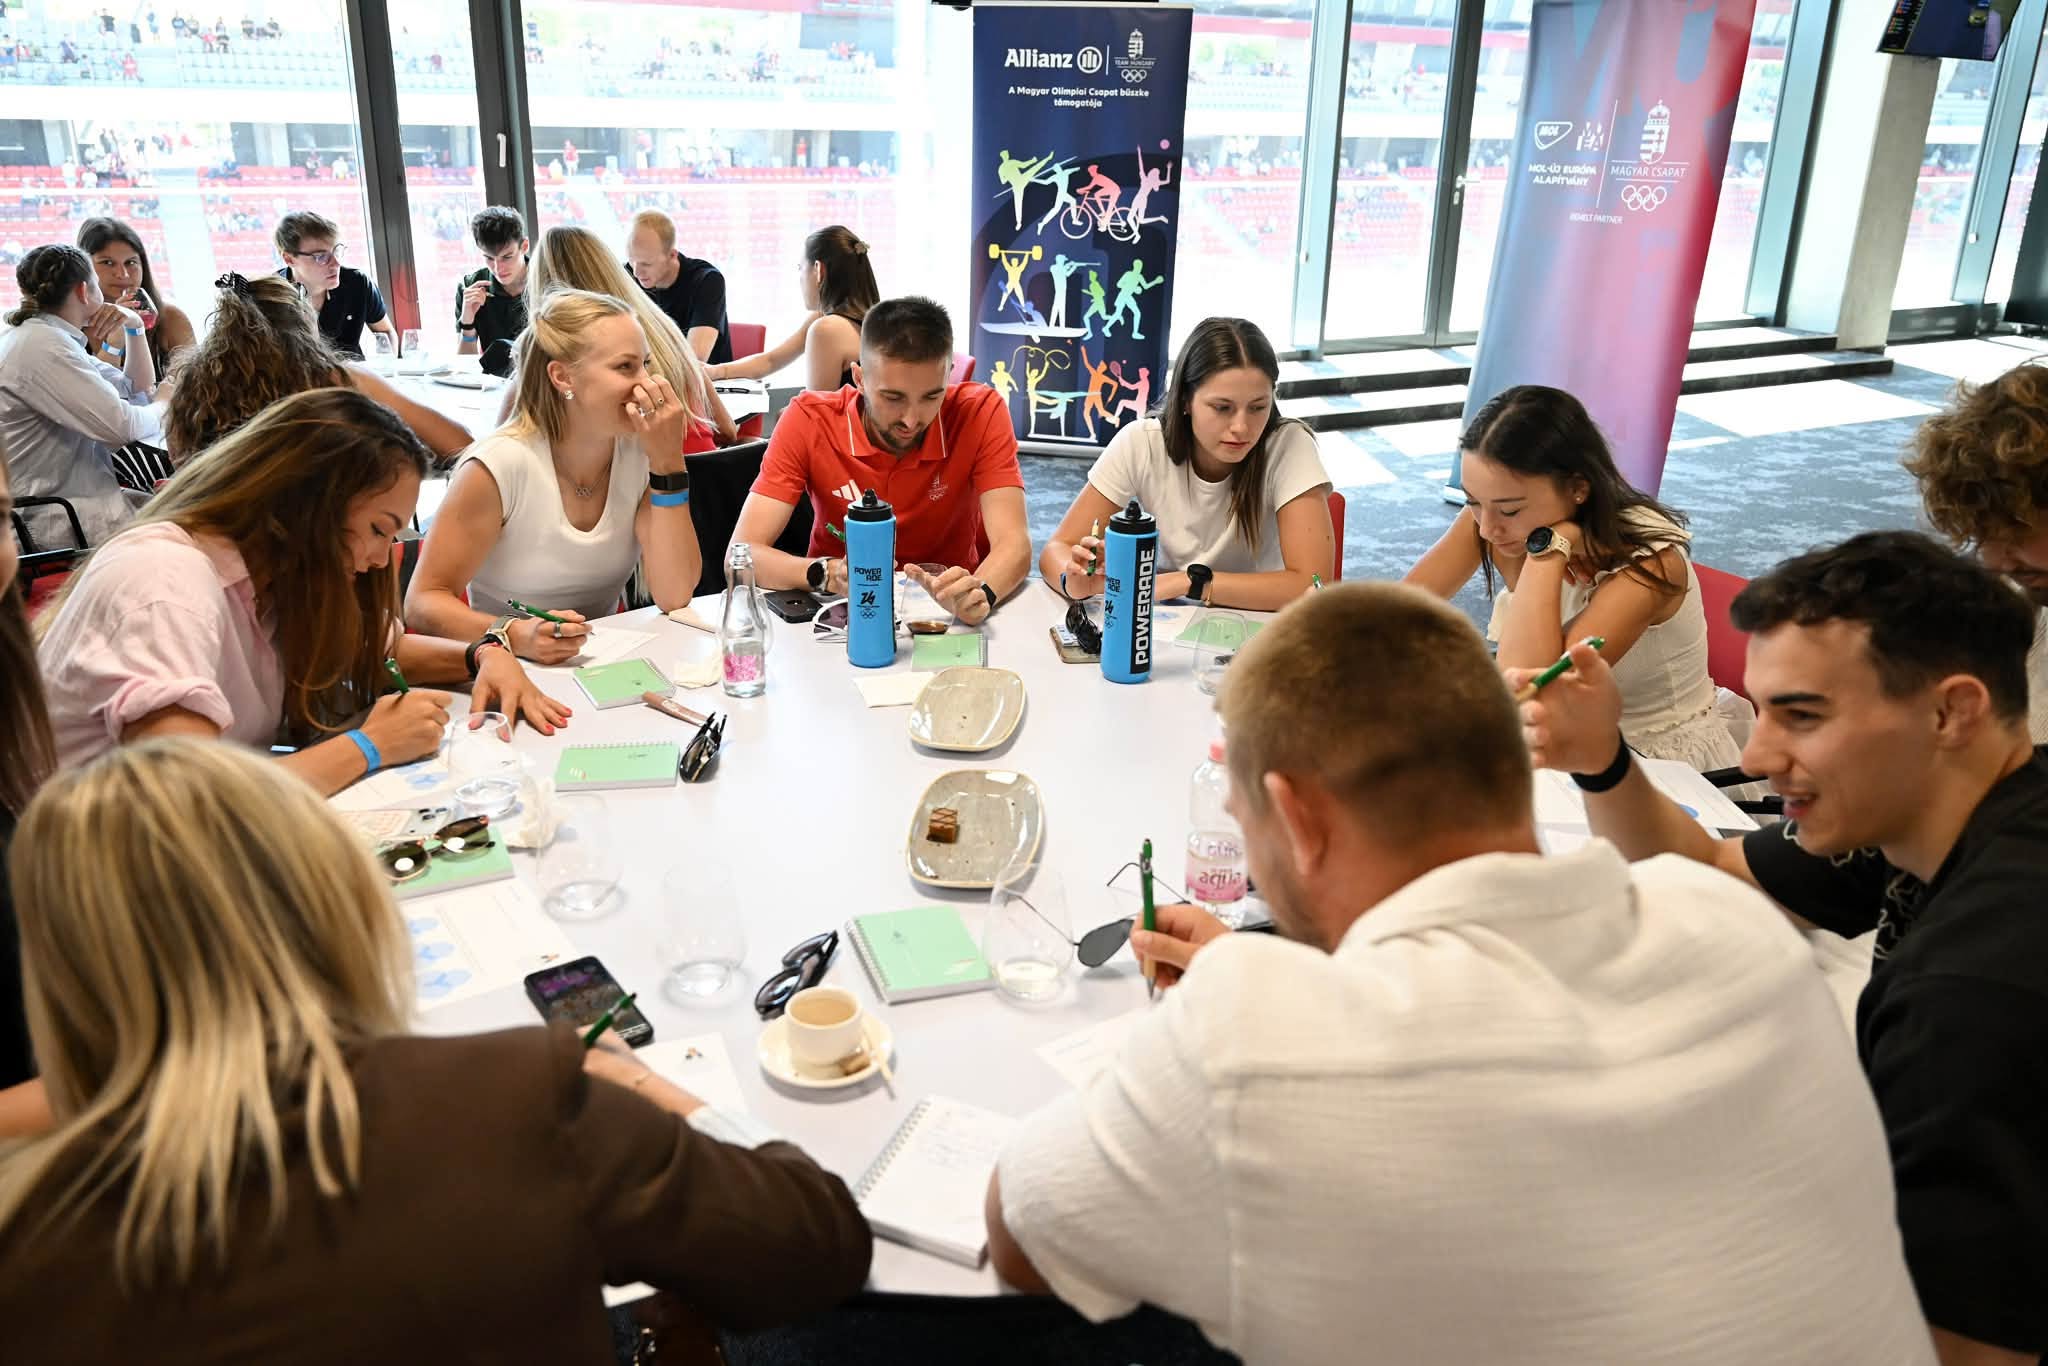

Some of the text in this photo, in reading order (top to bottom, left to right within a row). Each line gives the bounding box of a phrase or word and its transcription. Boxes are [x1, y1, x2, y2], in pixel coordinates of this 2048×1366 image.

[1004, 48, 1073, 68] Allianz
[1008, 87, 1149, 98] A Magyar Olimpiai Csapat büszke
[1054, 98, 1103, 109] támogatója
[1539, 125, 1559, 136] MOL
[1563, 162, 1597, 176] EURÓPA
[1610, 166, 1686, 178] MAGYAR CSAPAT
[1533, 174, 1590, 187] ALAPÍTVÁNY
[854, 567, 882, 576] POWER
[1135, 548, 1155, 665] POWERADE
